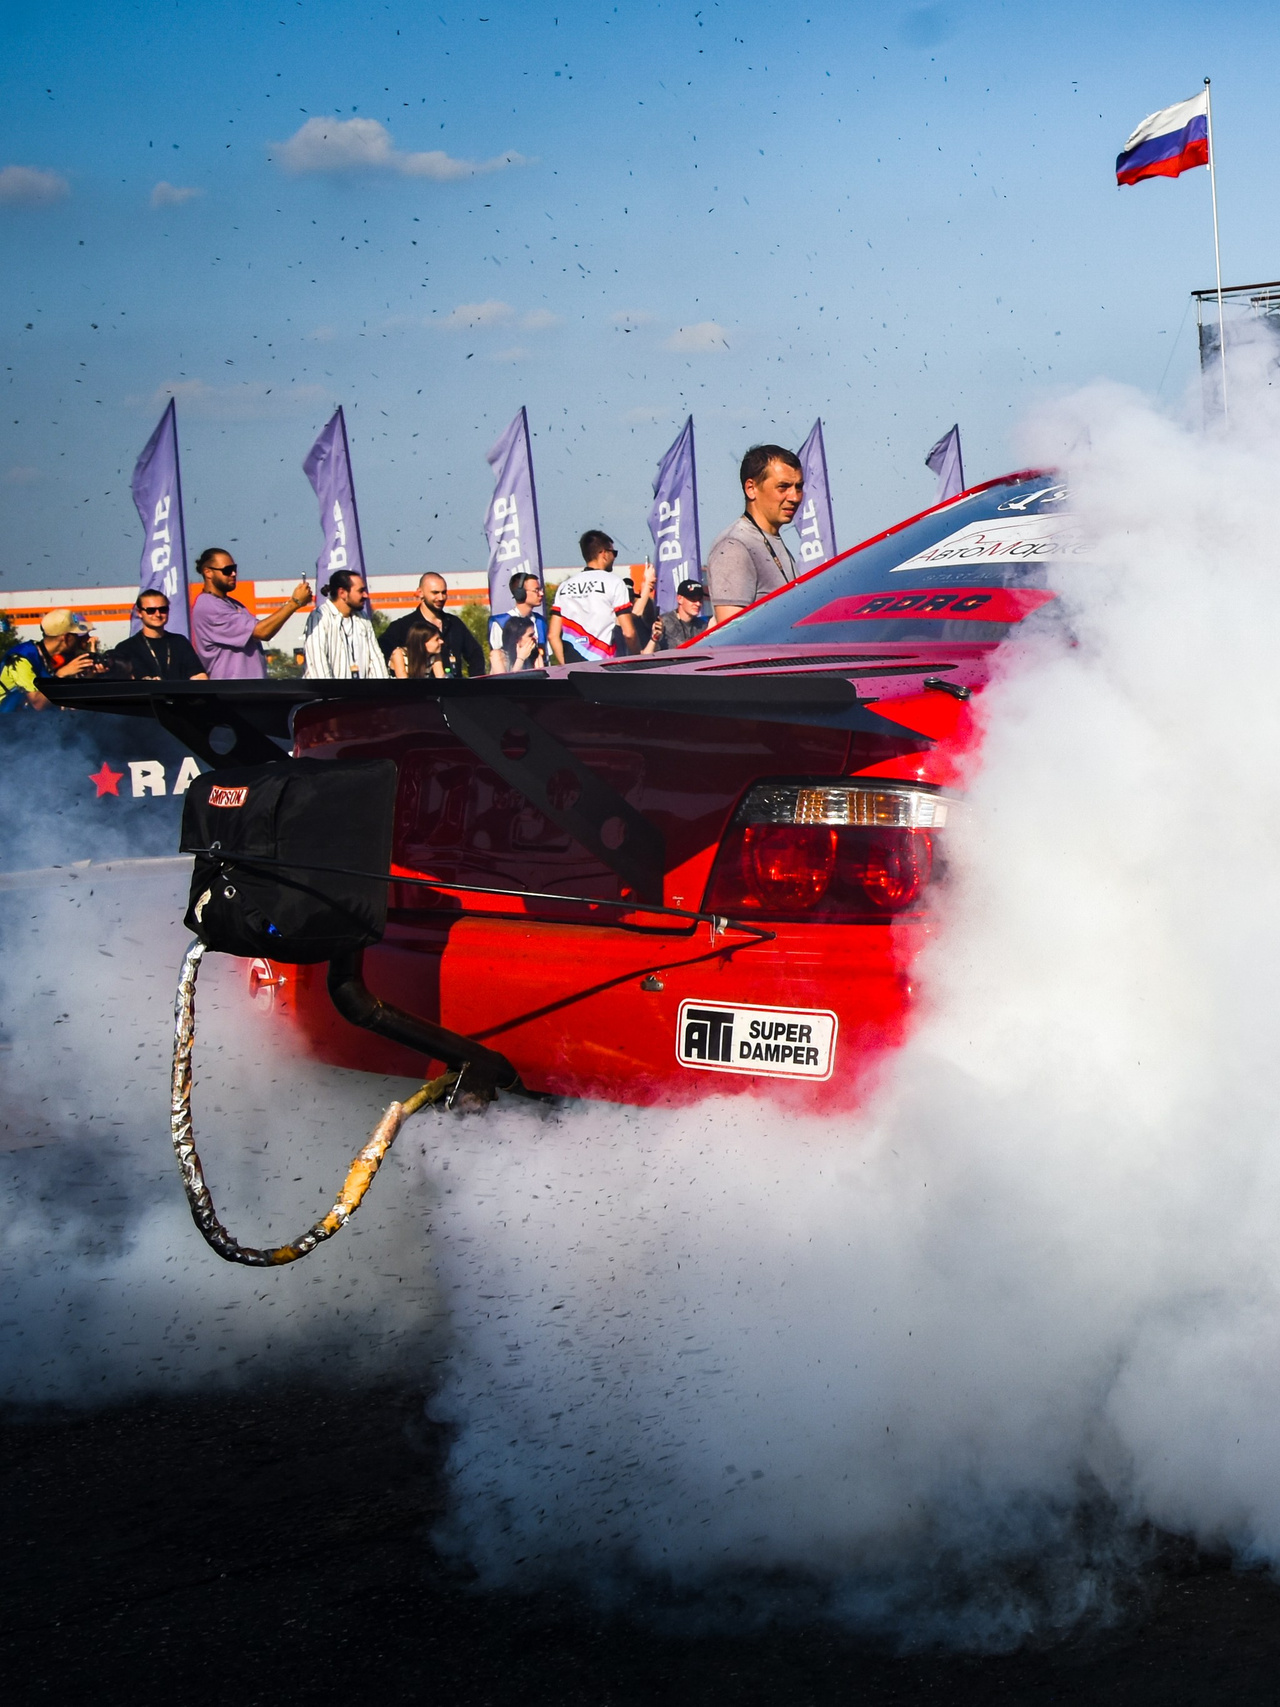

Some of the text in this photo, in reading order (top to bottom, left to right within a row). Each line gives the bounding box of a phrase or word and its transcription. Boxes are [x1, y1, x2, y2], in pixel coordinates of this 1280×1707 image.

[853, 594, 992, 614] RDRC
[684, 1008, 734, 1062] ATI
[748, 1020, 812, 1043] SUPER
[739, 1041, 819, 1066] DAMPER
